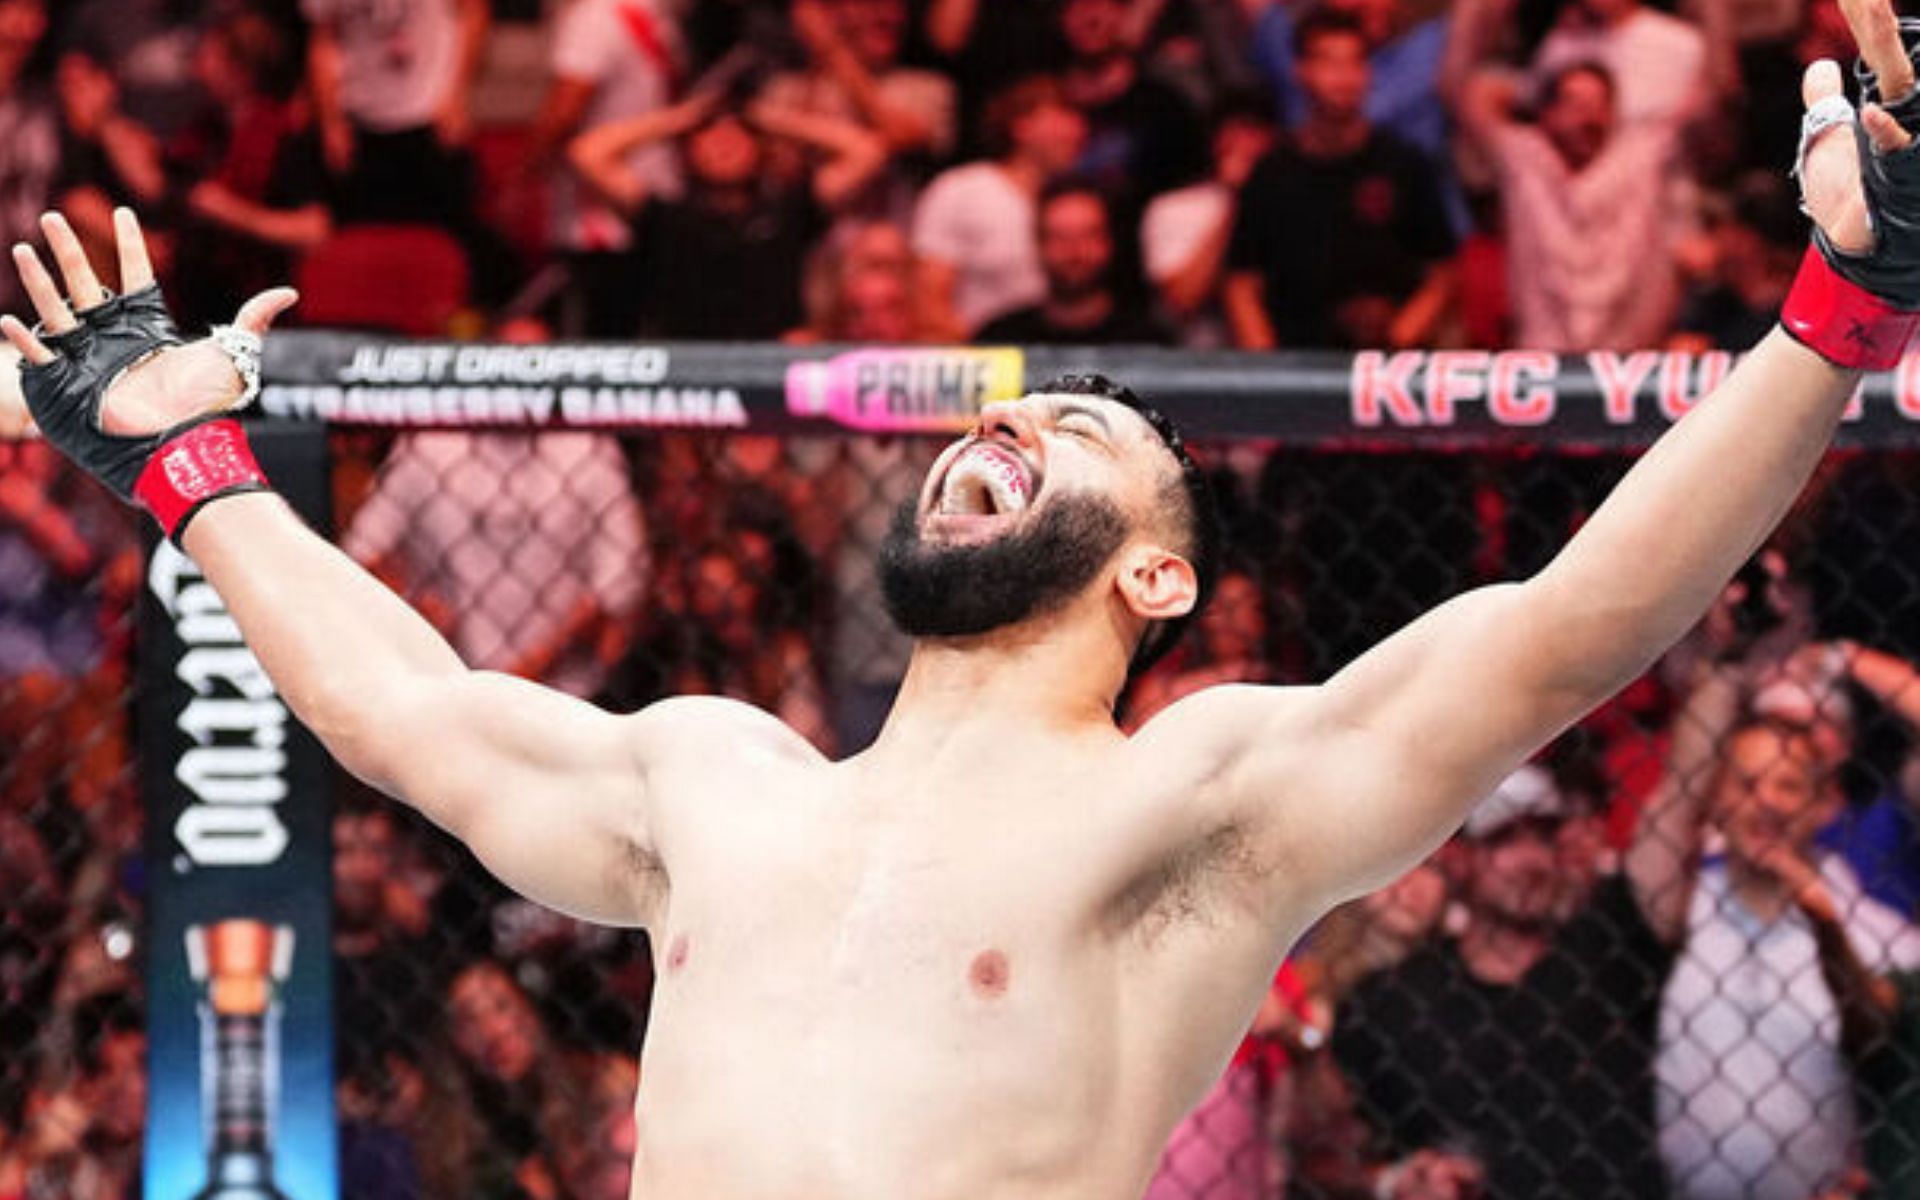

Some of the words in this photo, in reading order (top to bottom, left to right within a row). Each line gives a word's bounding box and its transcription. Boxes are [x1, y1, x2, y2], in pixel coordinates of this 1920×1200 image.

[337, 346, 453, 384] JUST
[455, 346, 670, 384] DROPPED
[854, 361, 993, 418] PRIME
[1351, 349, 1557, 425] KFC
[261, 384, 554, 424] STRAWBERRY
[561, 386, 748, 426] BANANA
